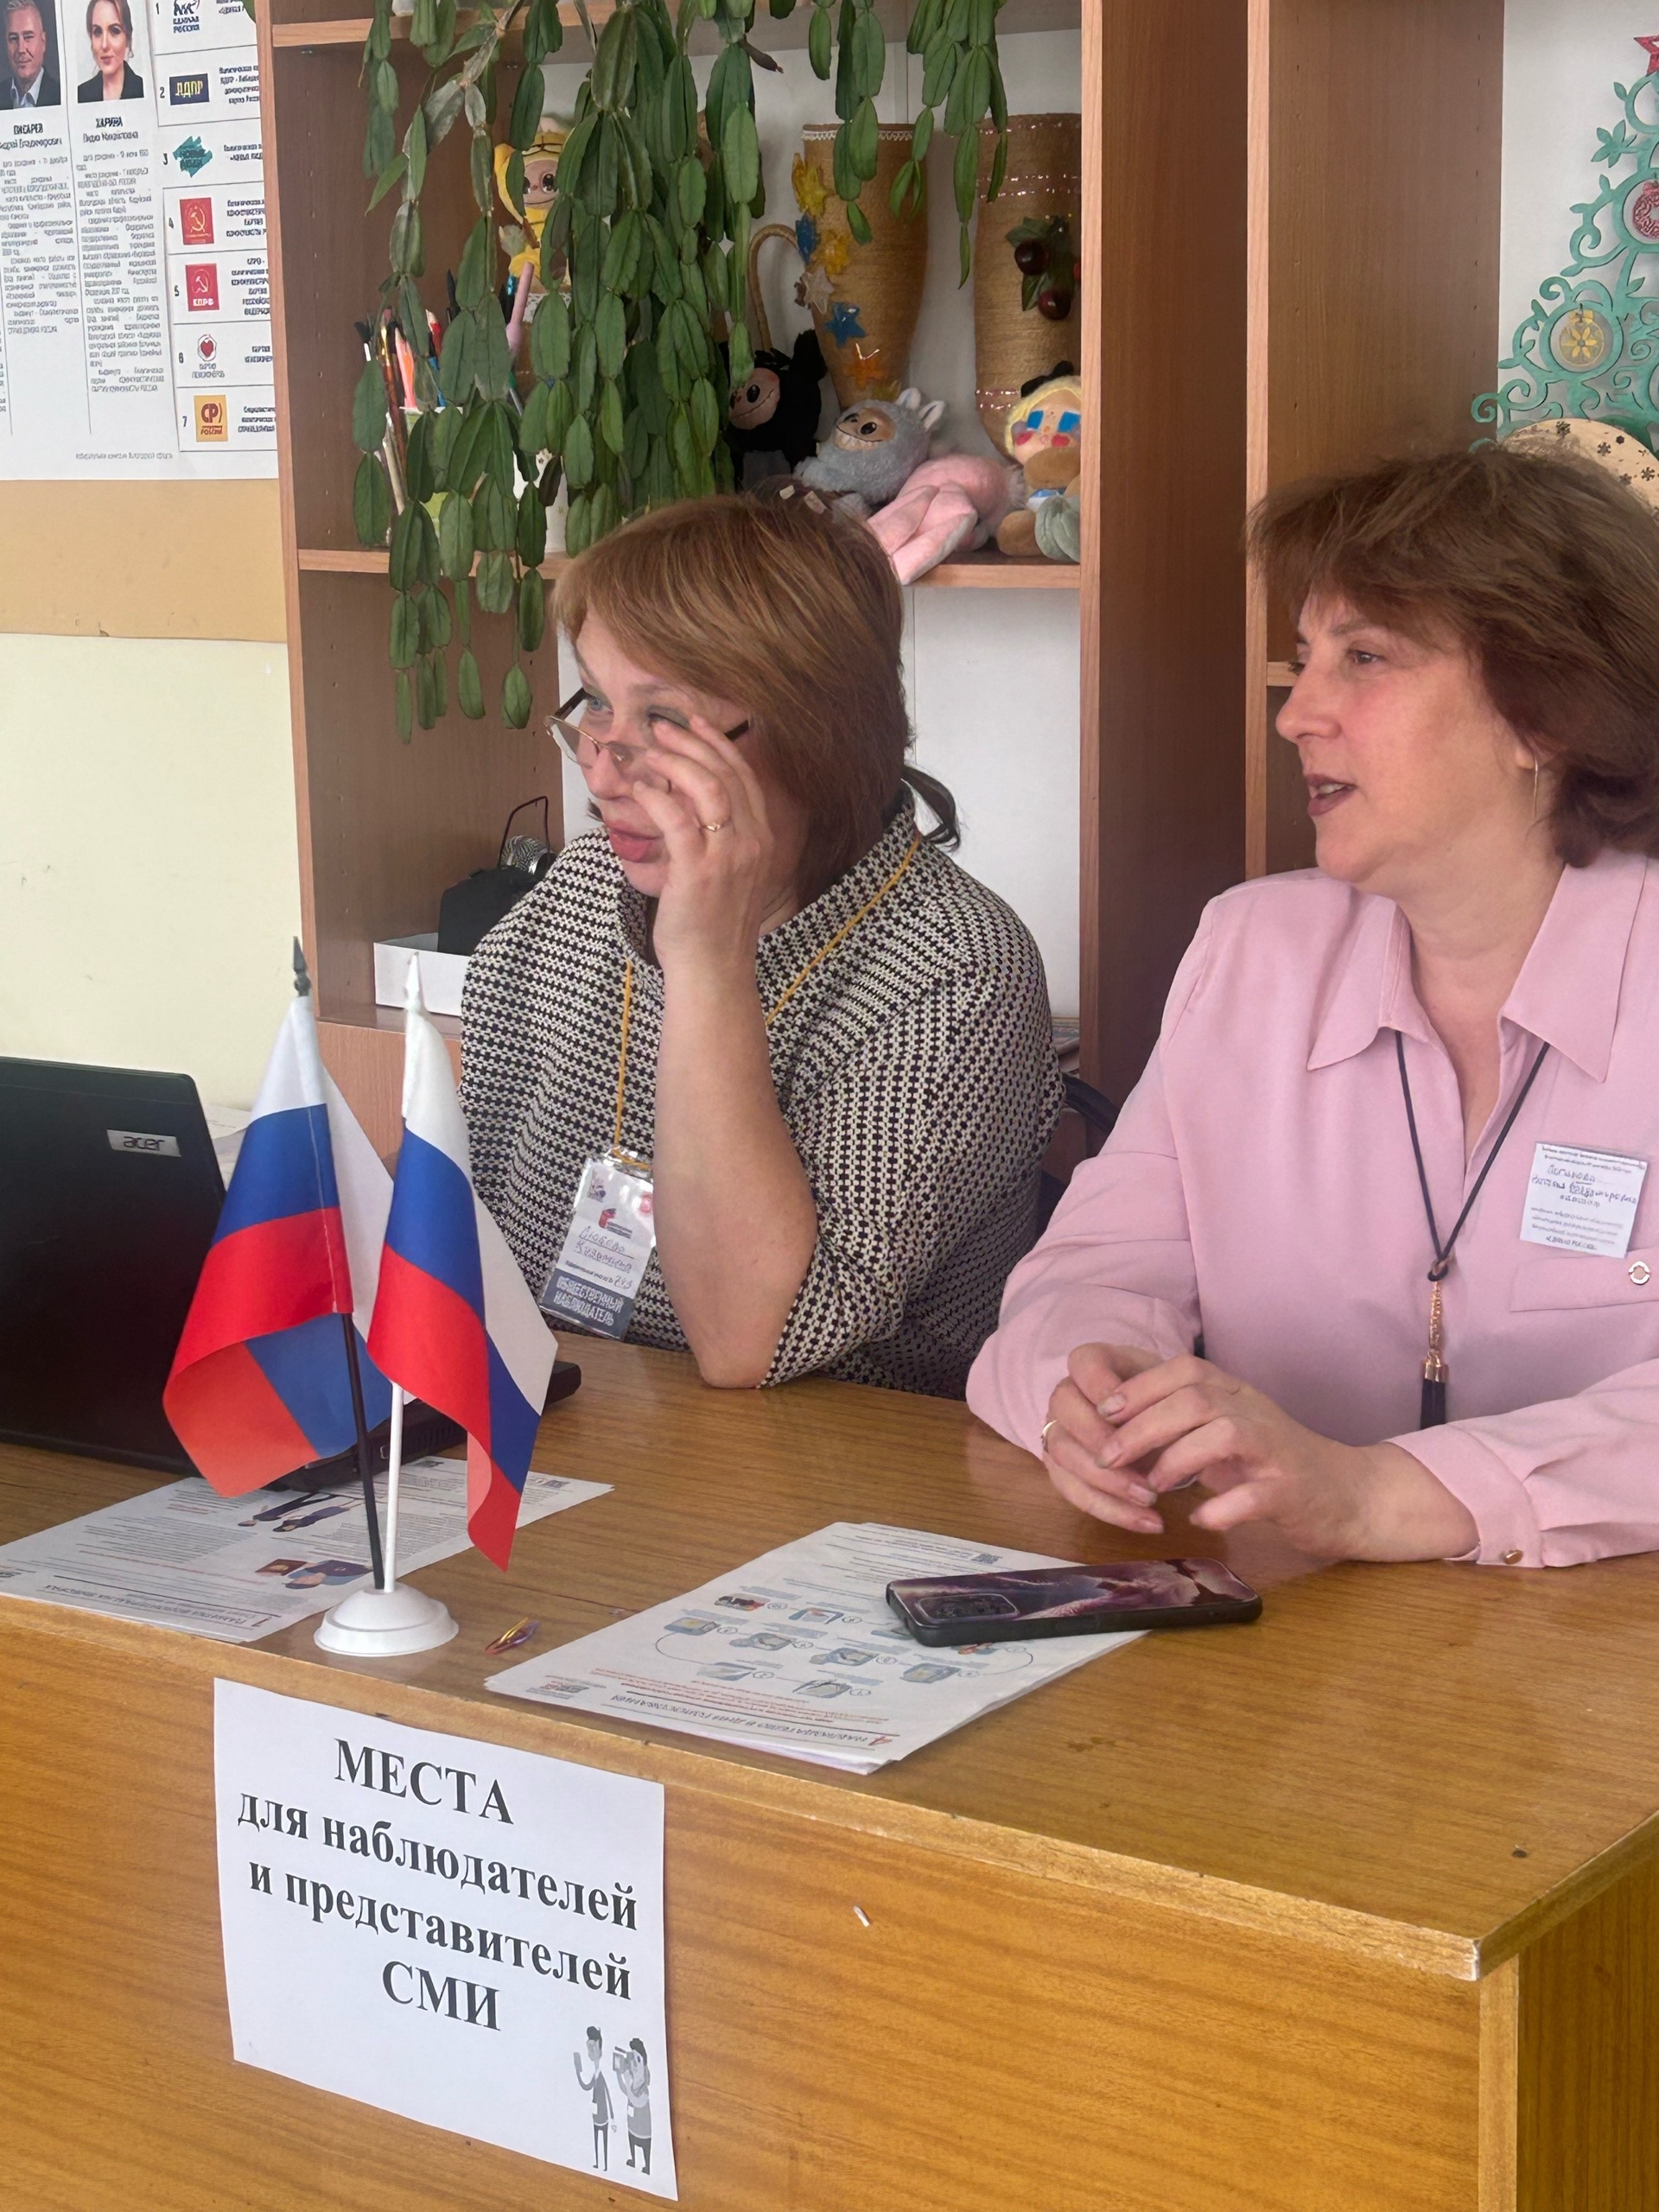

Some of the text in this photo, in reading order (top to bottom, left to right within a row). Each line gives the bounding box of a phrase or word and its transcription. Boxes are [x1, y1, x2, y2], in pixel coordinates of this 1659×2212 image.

[160, 86, 165, 99] 2
[175, 80, 203, 97] ЛДПР
[163, 153, 168, 166] 3
[175, 284, 180, 296] 5
[182, 416, 188, 427] 7
[124, 1136, 165, 1151] acer
[334, 1738, 513, 1825] МЕСТА
[238, 1793, 637, 1931] для наблюдателей
[250, 1861, 631, 2000] и представителей
[383, 1960, 500, 2031] СМИ
